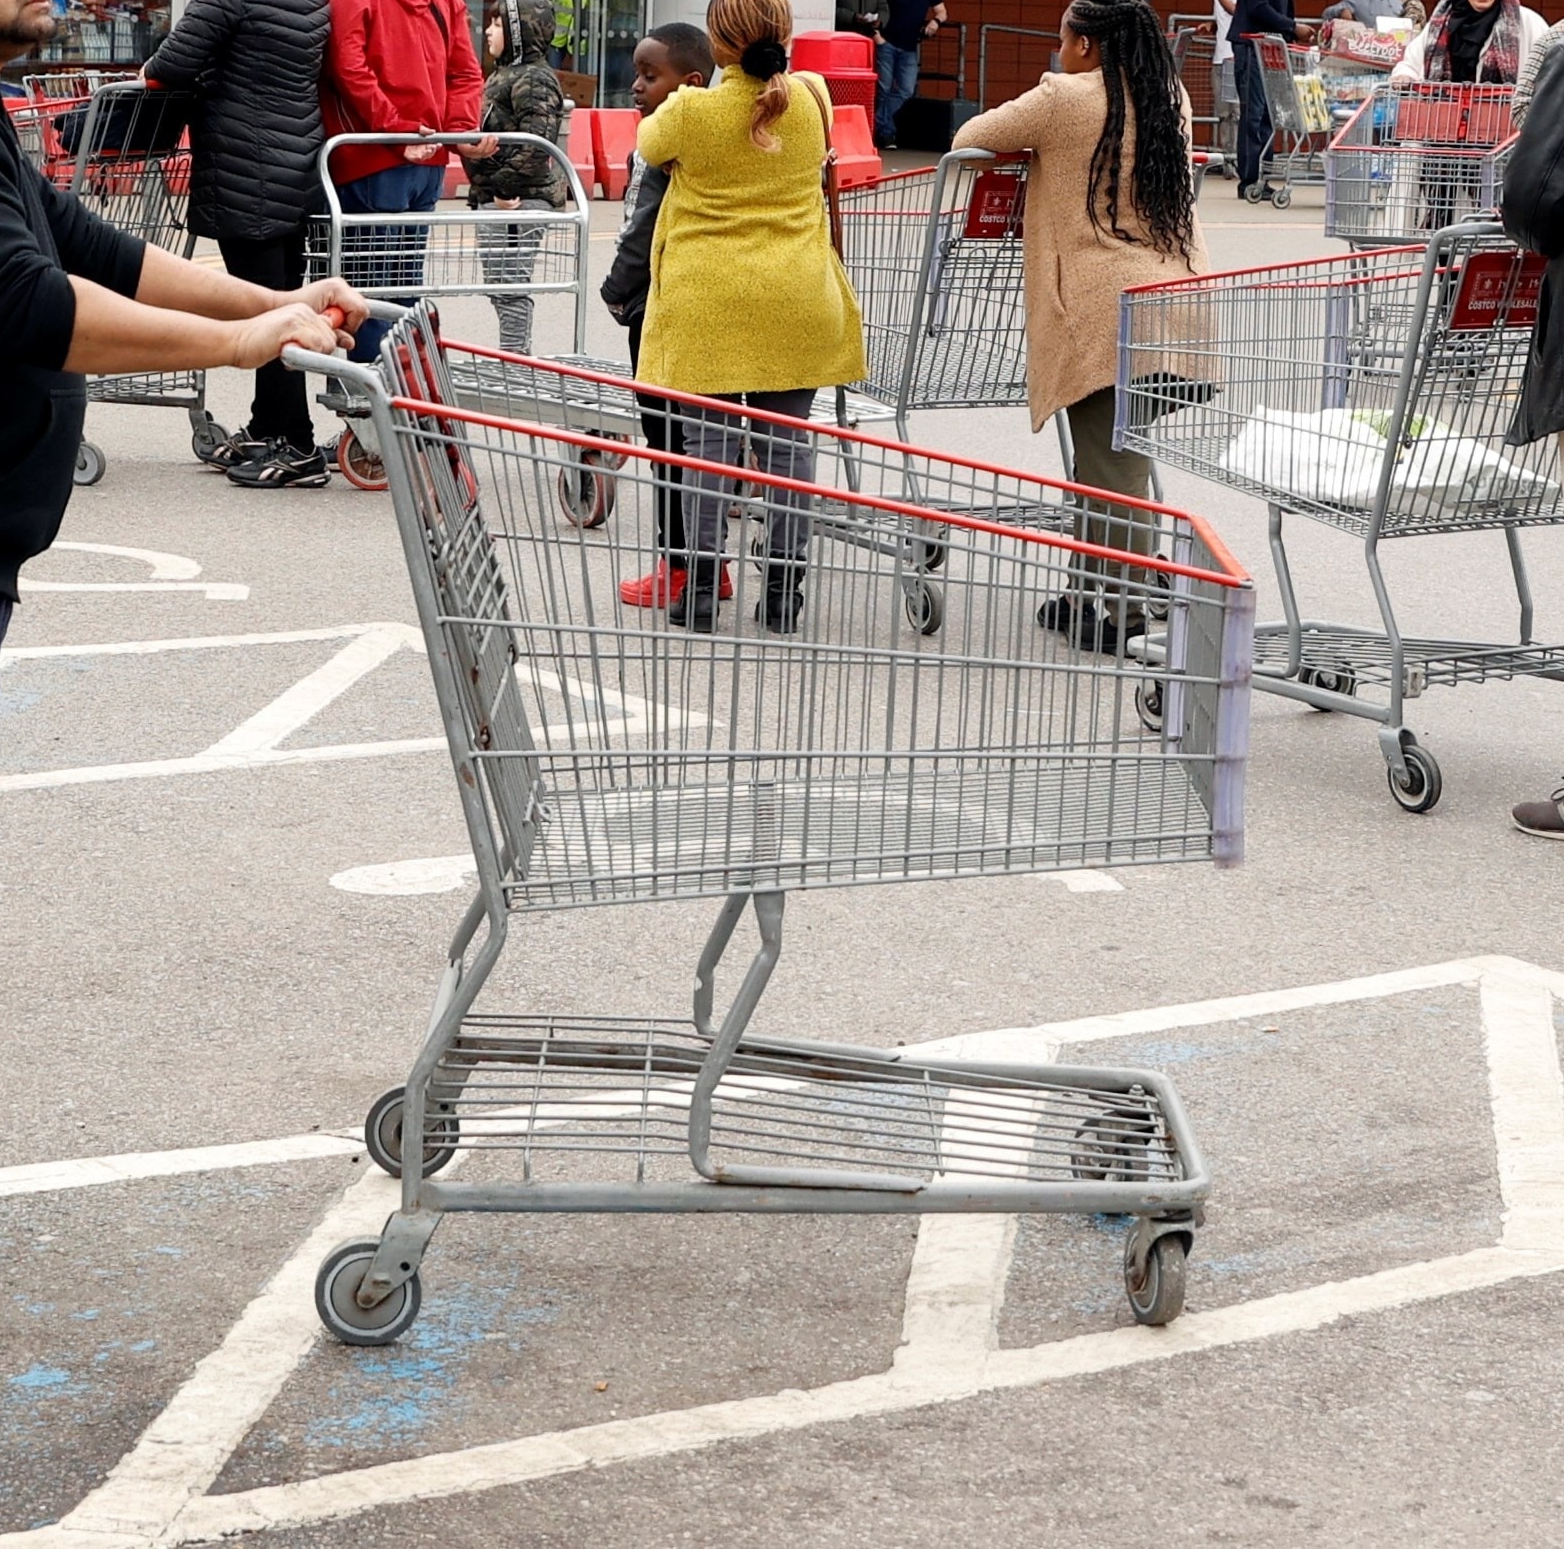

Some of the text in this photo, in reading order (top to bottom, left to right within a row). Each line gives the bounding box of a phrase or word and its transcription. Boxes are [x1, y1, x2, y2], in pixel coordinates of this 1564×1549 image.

[1348, 38, 1403, 57] Beetroot
[979, 214, 1006, 223] COSTCO
[1468, 300, 1496, 310] COSTCO
